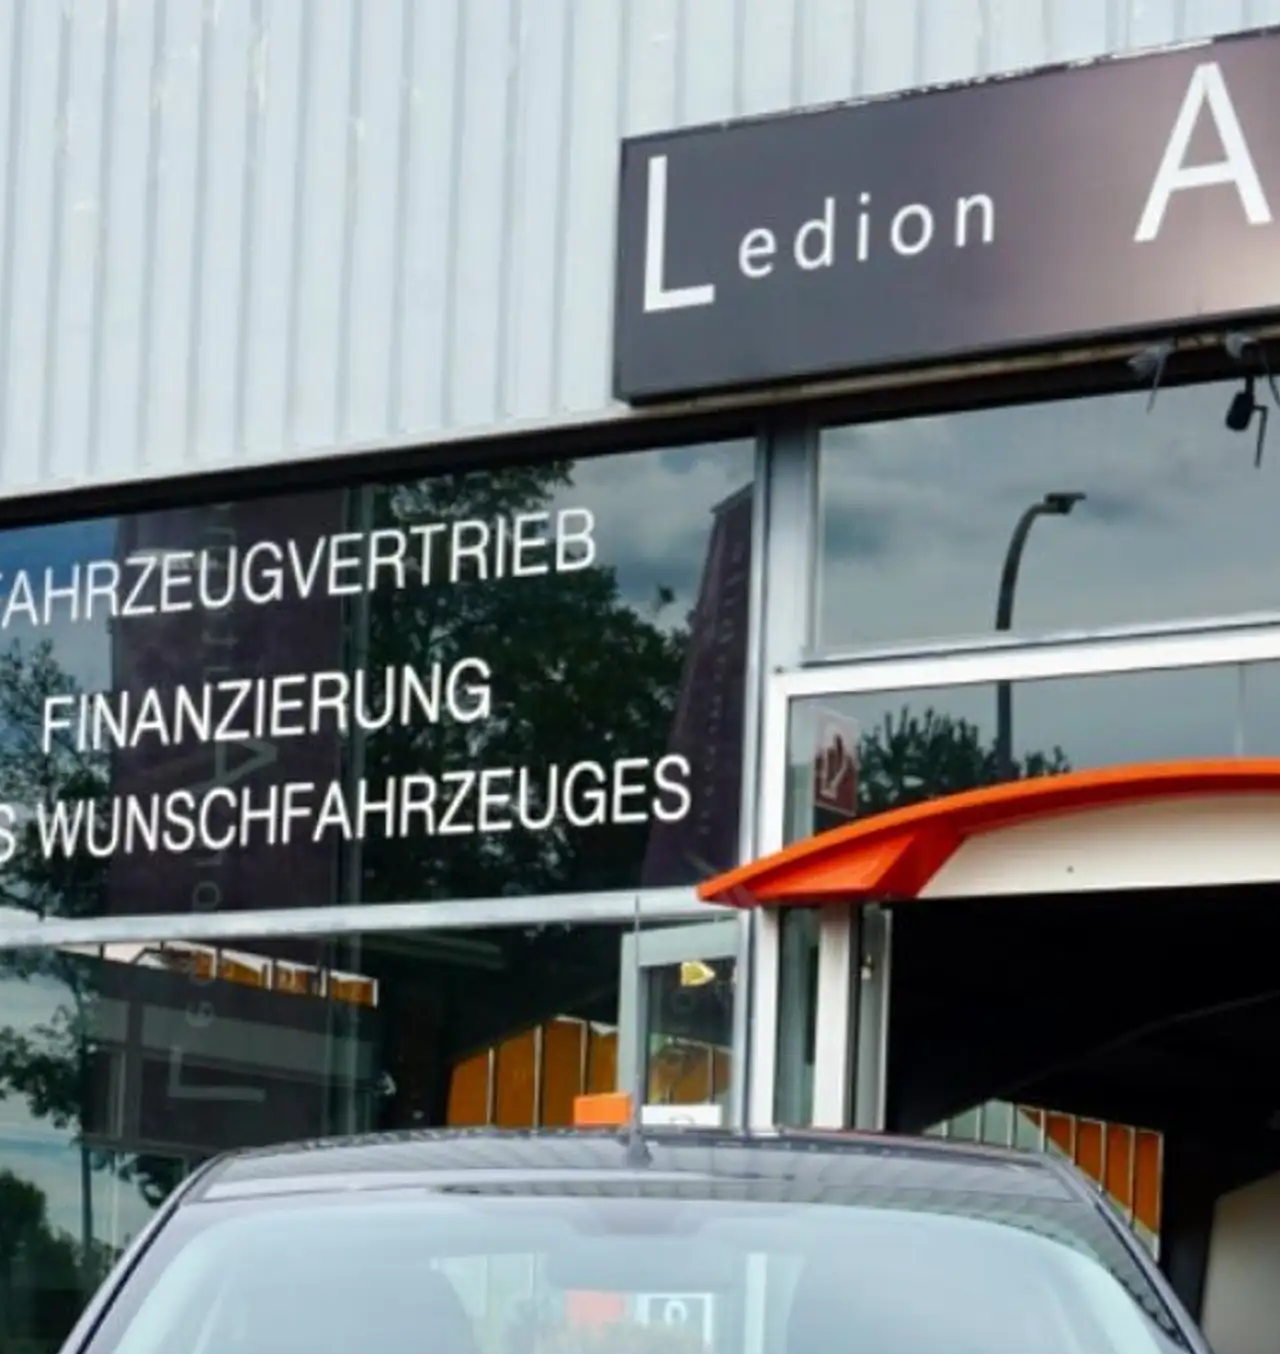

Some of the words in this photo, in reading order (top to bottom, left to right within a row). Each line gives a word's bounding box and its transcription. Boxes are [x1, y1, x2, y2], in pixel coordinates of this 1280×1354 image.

[642, 155, 996, 312] Ledion
[40, 656, 492, 755] FINANZIERUNG
[34, 753, 693, 859] WUNSCHFAHRZEUGES
